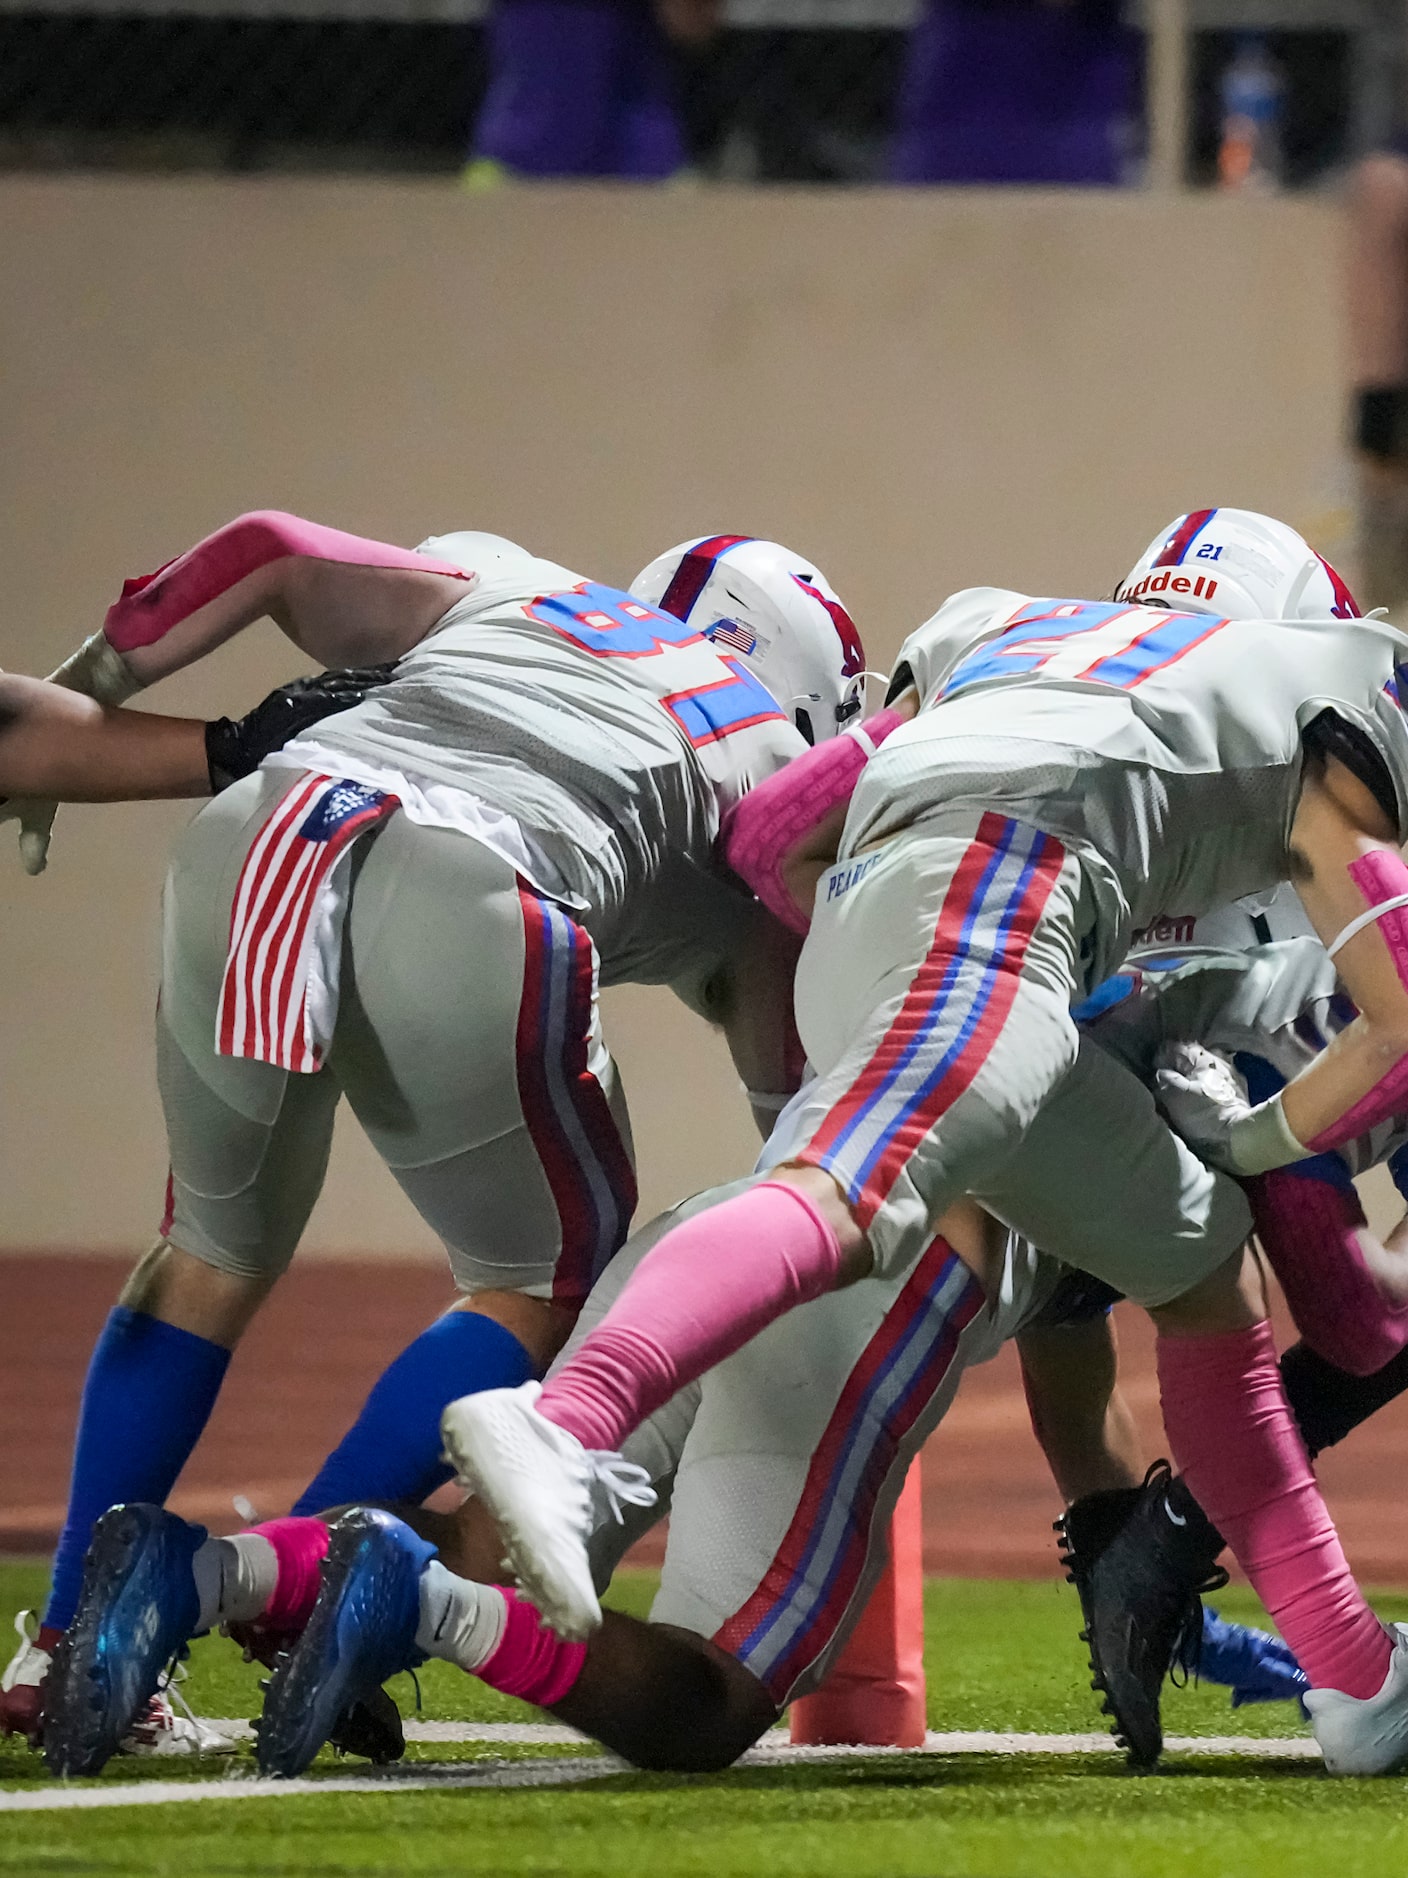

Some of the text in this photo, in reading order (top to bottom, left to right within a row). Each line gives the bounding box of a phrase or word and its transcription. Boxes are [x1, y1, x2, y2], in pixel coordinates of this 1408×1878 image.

[1196, 543, 1223, 560] 21
[521, 581, 789, 750] 81
[935, 599, 1233, 702] 21
